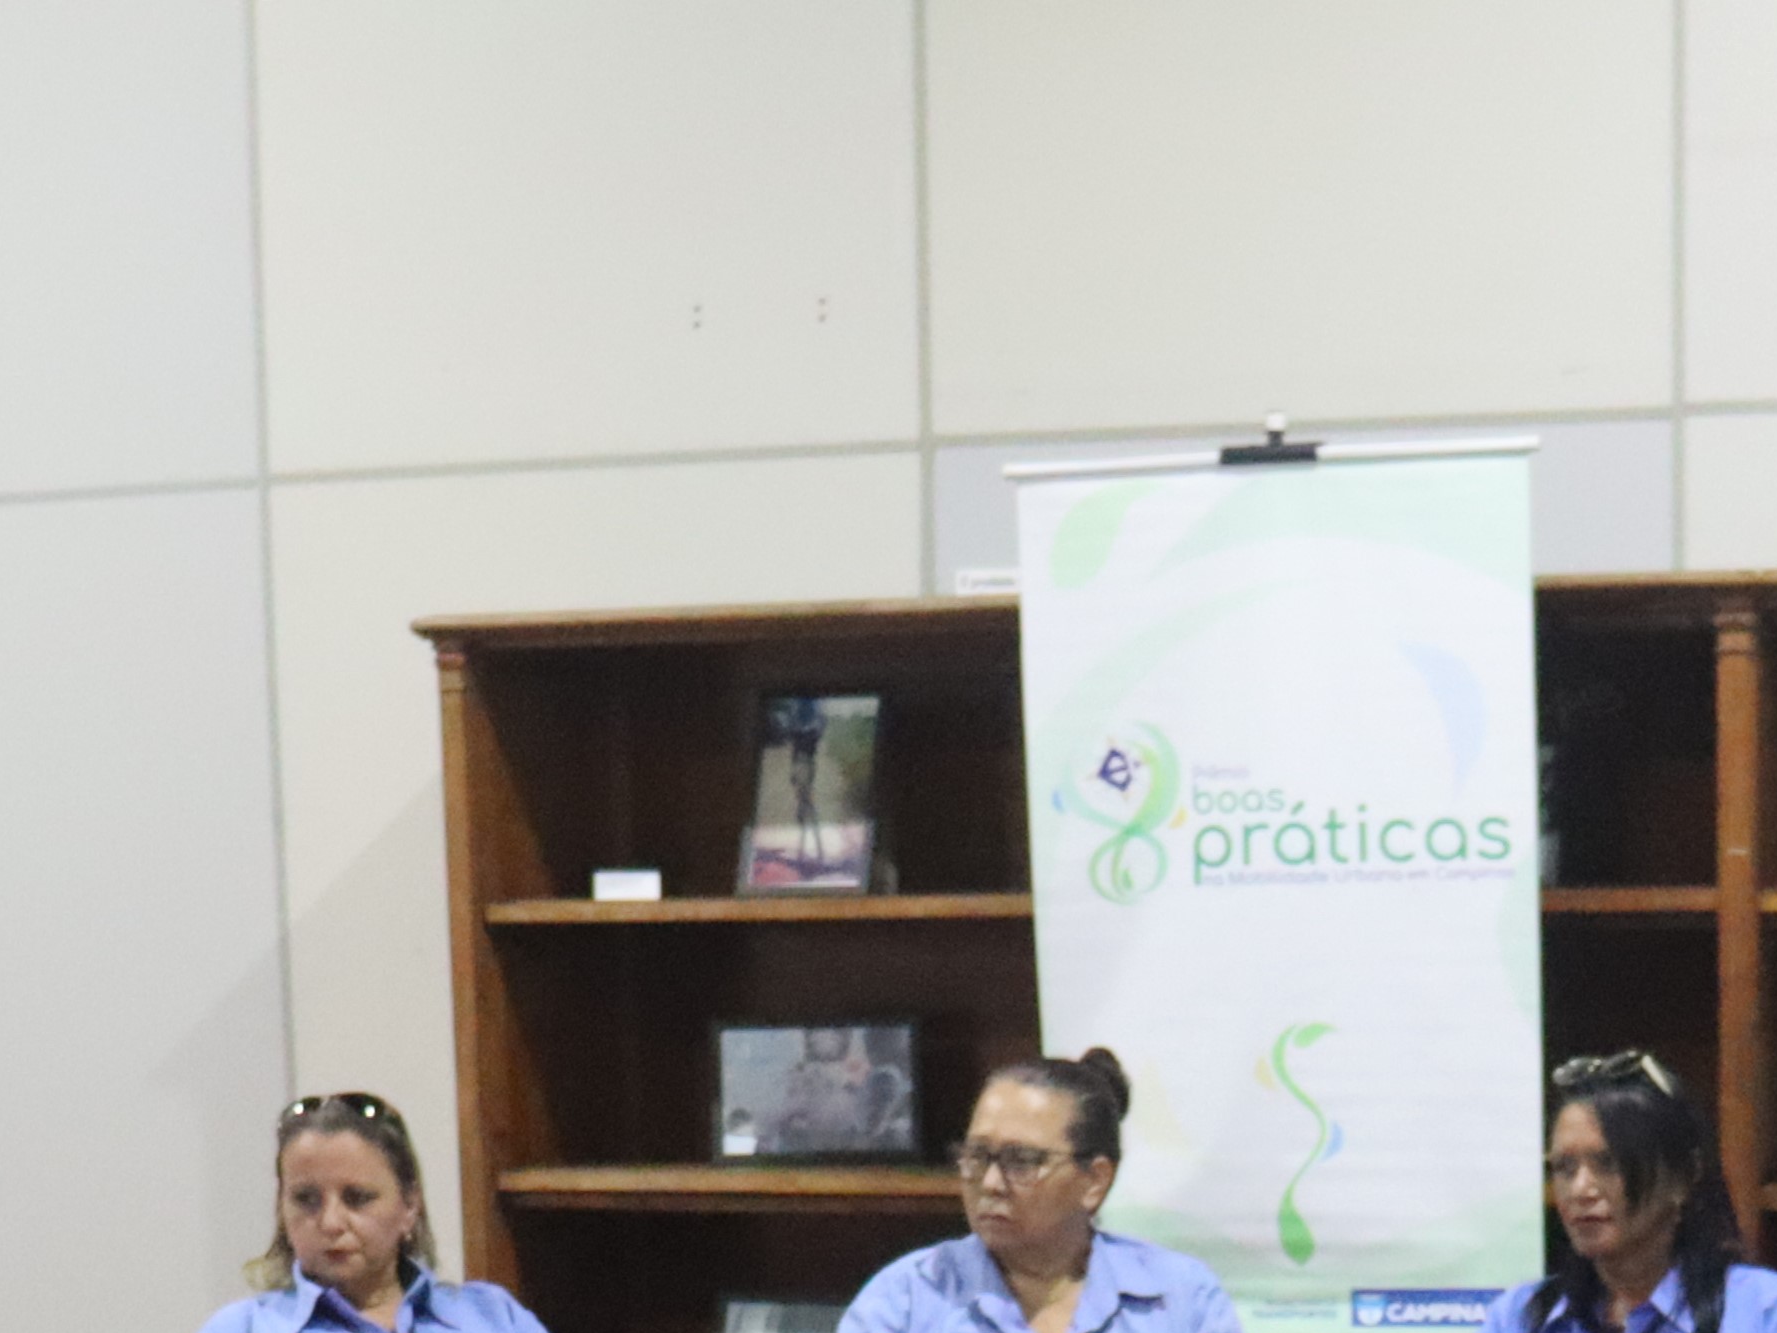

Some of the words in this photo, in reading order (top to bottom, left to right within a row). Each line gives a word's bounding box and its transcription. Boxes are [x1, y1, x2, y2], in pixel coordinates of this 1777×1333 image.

[1192, 784, 1286, 815] boas
[1192, 799, 1513, 886] práticas
[1386, 1302, 1487, 1322] CAMPINA
